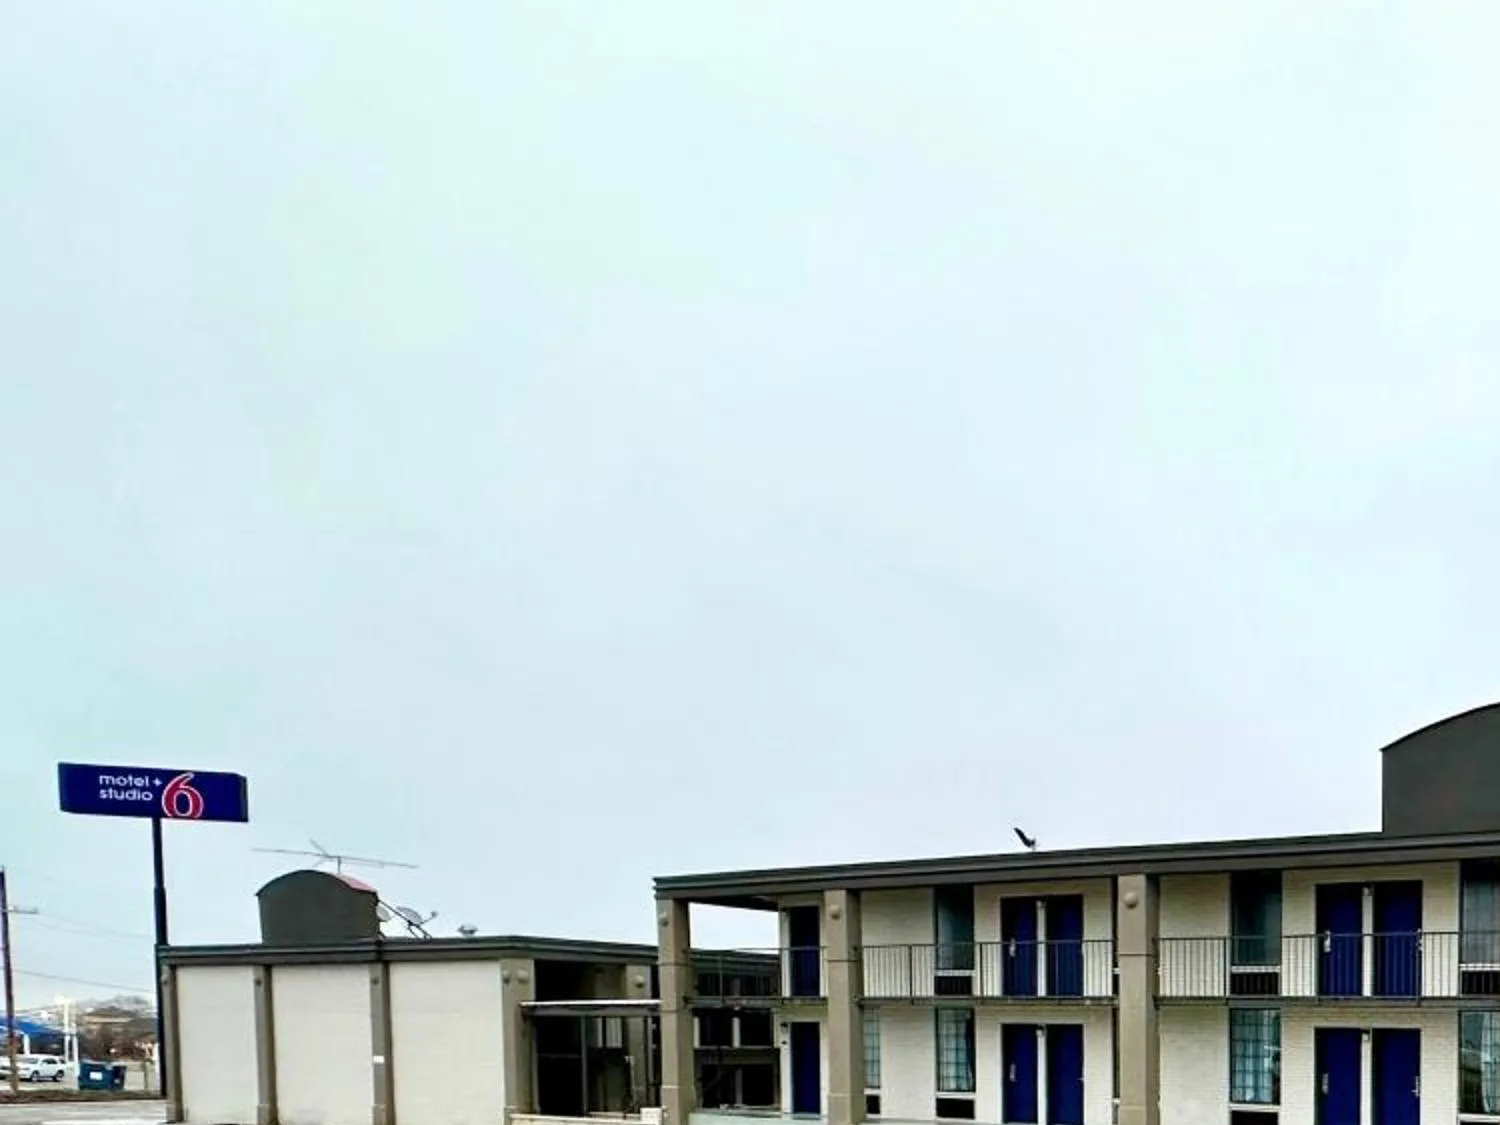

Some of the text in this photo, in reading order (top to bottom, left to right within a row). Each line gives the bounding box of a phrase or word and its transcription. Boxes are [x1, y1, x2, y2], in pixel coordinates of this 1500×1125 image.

[99, 775, 149, 786] motel
[99, 788, 153, 801] studio
[161, 772, 205, 819] 6
